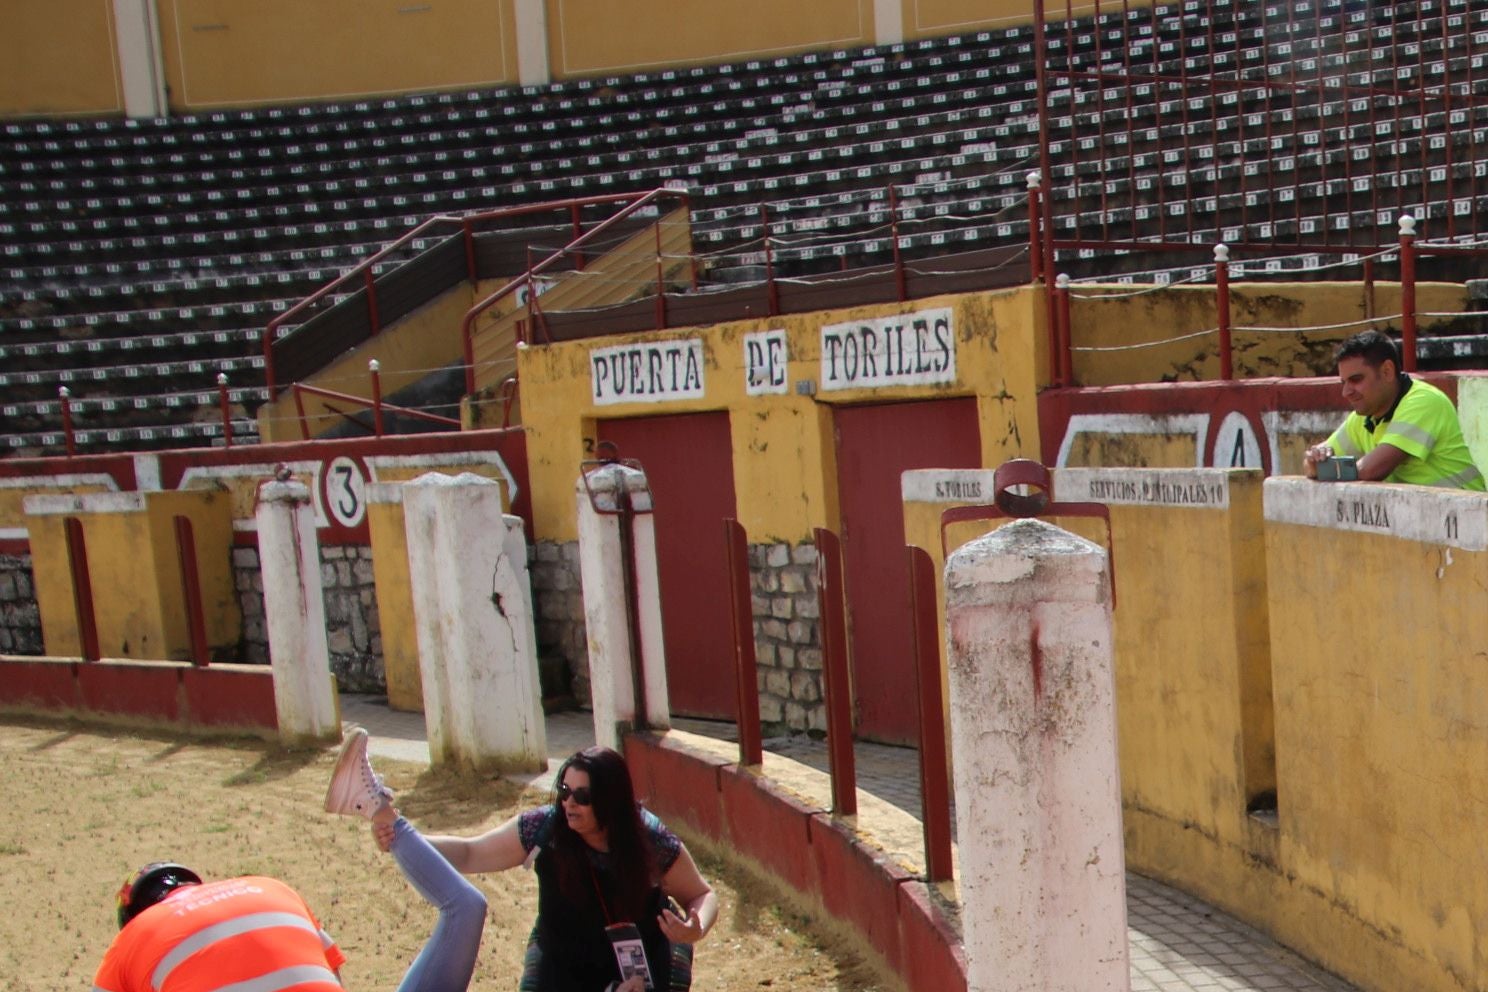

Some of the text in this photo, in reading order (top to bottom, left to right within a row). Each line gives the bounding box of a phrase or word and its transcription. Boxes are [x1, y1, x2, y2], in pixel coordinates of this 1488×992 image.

[593, 317, 952, 398] PUERTA DE TORILES
[336, 465, 358, 519] 3
[1210, 483, 1223, 503] 10
[1353, 500, 1390, 528] PLAZA
[1444, 515, 1459, 539] 11
